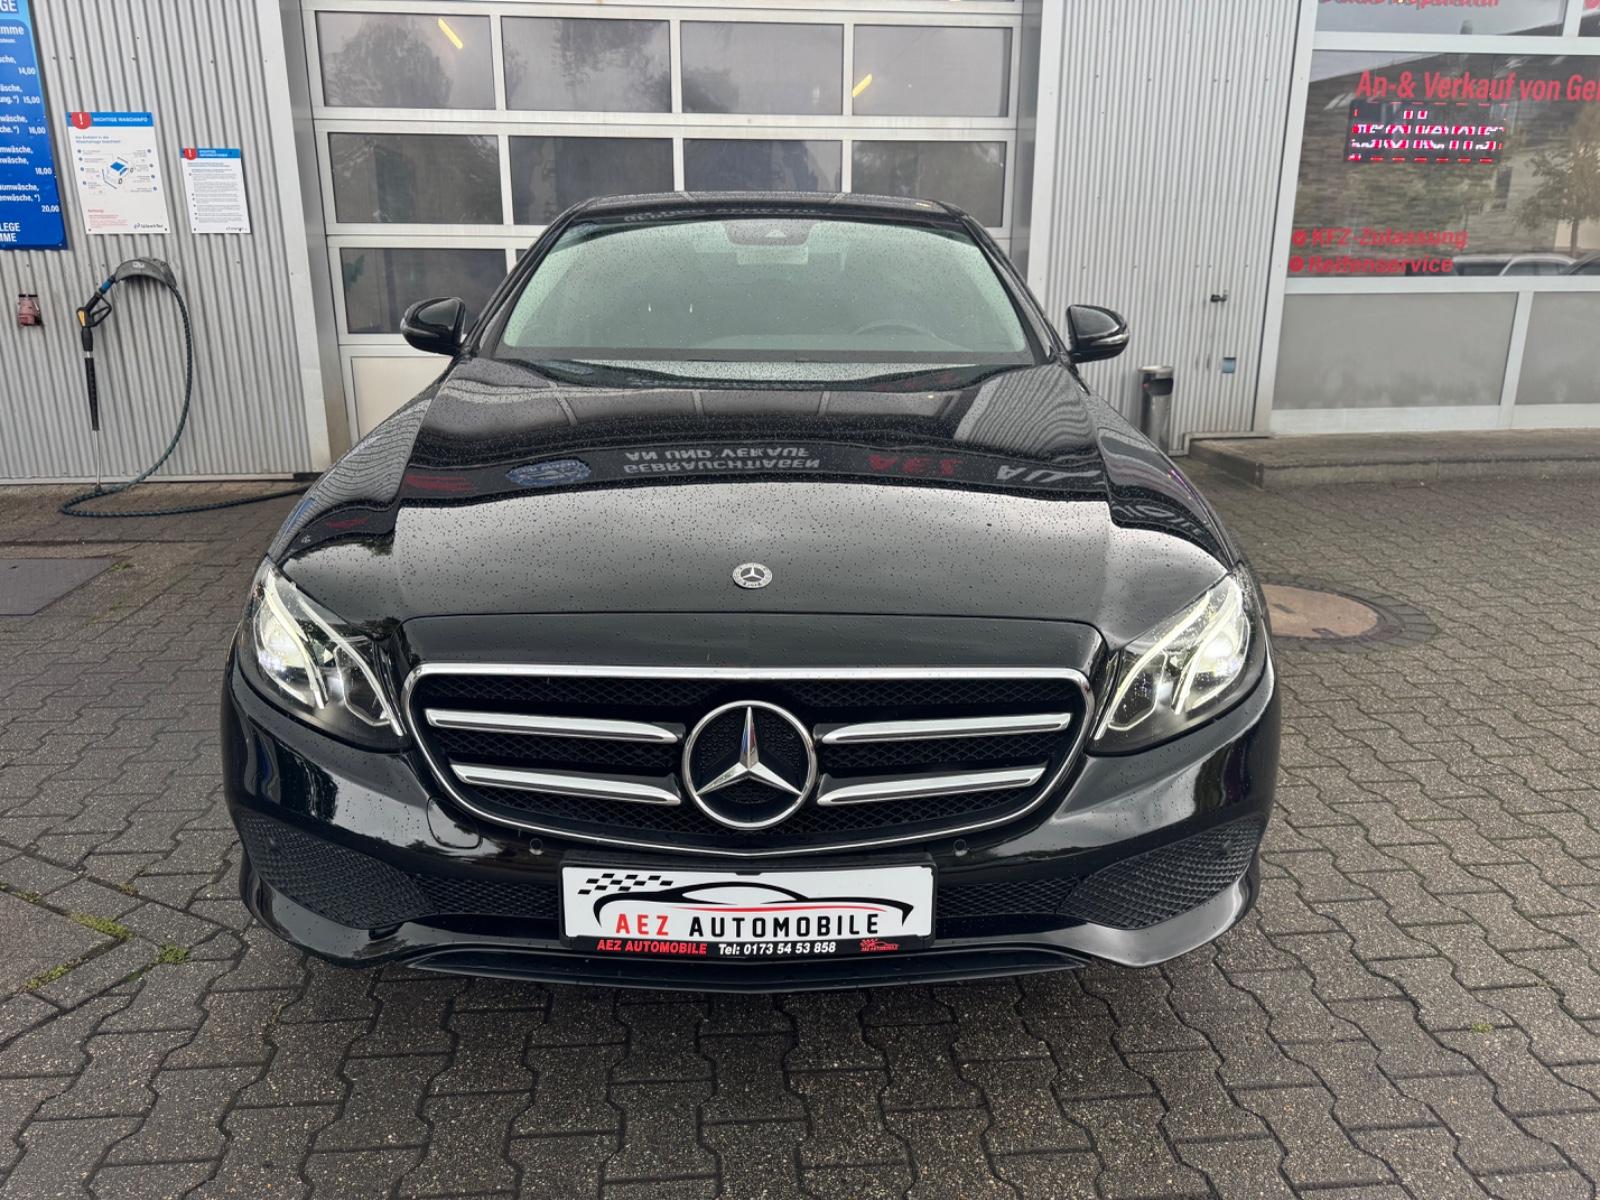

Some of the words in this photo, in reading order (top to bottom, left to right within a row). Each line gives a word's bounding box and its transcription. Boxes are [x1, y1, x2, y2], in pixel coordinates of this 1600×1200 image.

[1424, 71, 1517, 99] Verkauf
[1519, 79, 1561, 101] von
[1308, 255, 1454, 273] Reifenservice
[615, 913, 669, 936] AEZ
[689, 913, 879, 938] AUTOMOBILE
[597, 939, 622, 952] AEZ
[625, 940, 708, 955] AUTOMOBILE
[718, 943, 740, 956] Tel:
[743, 943, 774, 956] 0173
[777, 942, 792, 955] 54
[795, 942, 811, 955] 53
[813, 941, 837, 954] 858
